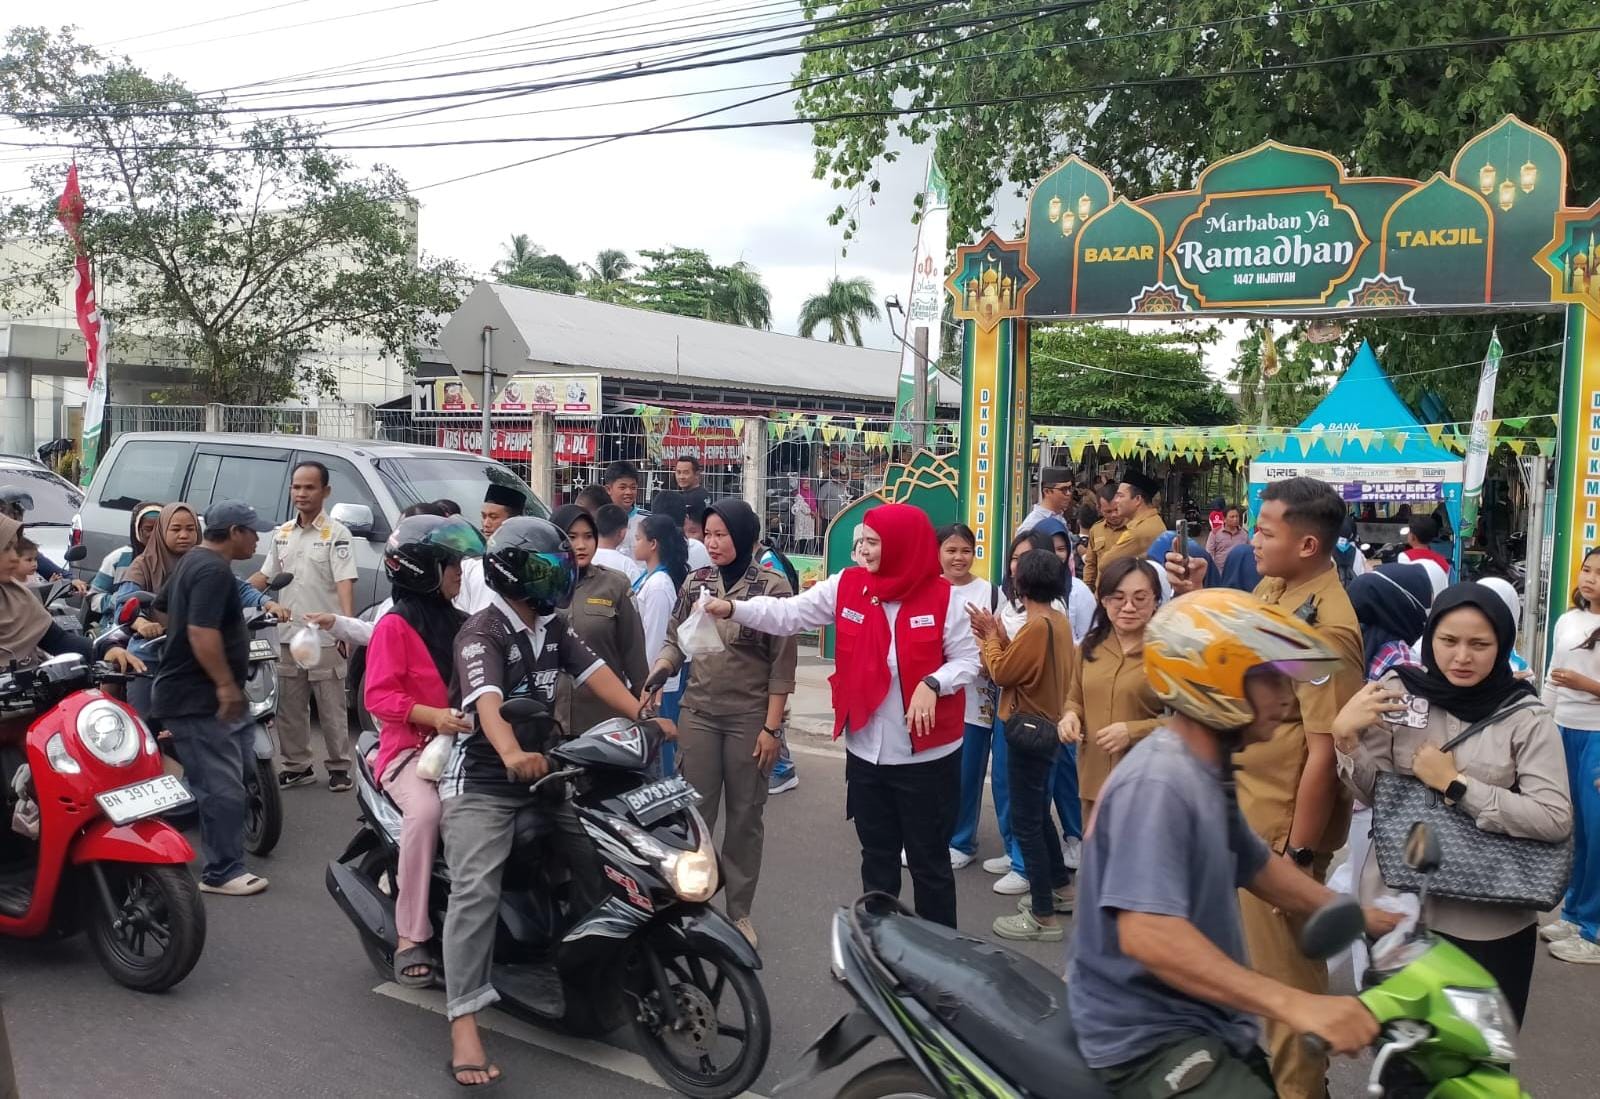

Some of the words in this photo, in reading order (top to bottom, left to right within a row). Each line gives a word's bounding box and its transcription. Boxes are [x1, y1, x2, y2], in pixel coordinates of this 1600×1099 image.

[1205, 212, 1300, 233] Marhaban
[1304, 209, 1329, 233] Ya
[1396, 228, 1482, 247] TAKJIL
[1084, 245, 1154, 262] BAZAR
[1176, 234, 1353, 273] Ramadhan
[1233, 273, 1254, 285] 1447
[1256, 272, 1296, 284] HIJRIYAH
[504, 432, 532, 451] PEMPE
[975, 389, 989, 559] DKUKMINDAG
[102, 794, 123, 807] BN
[125, 783, 158, 800] 3912
[161, 777, 177, 790] EF
